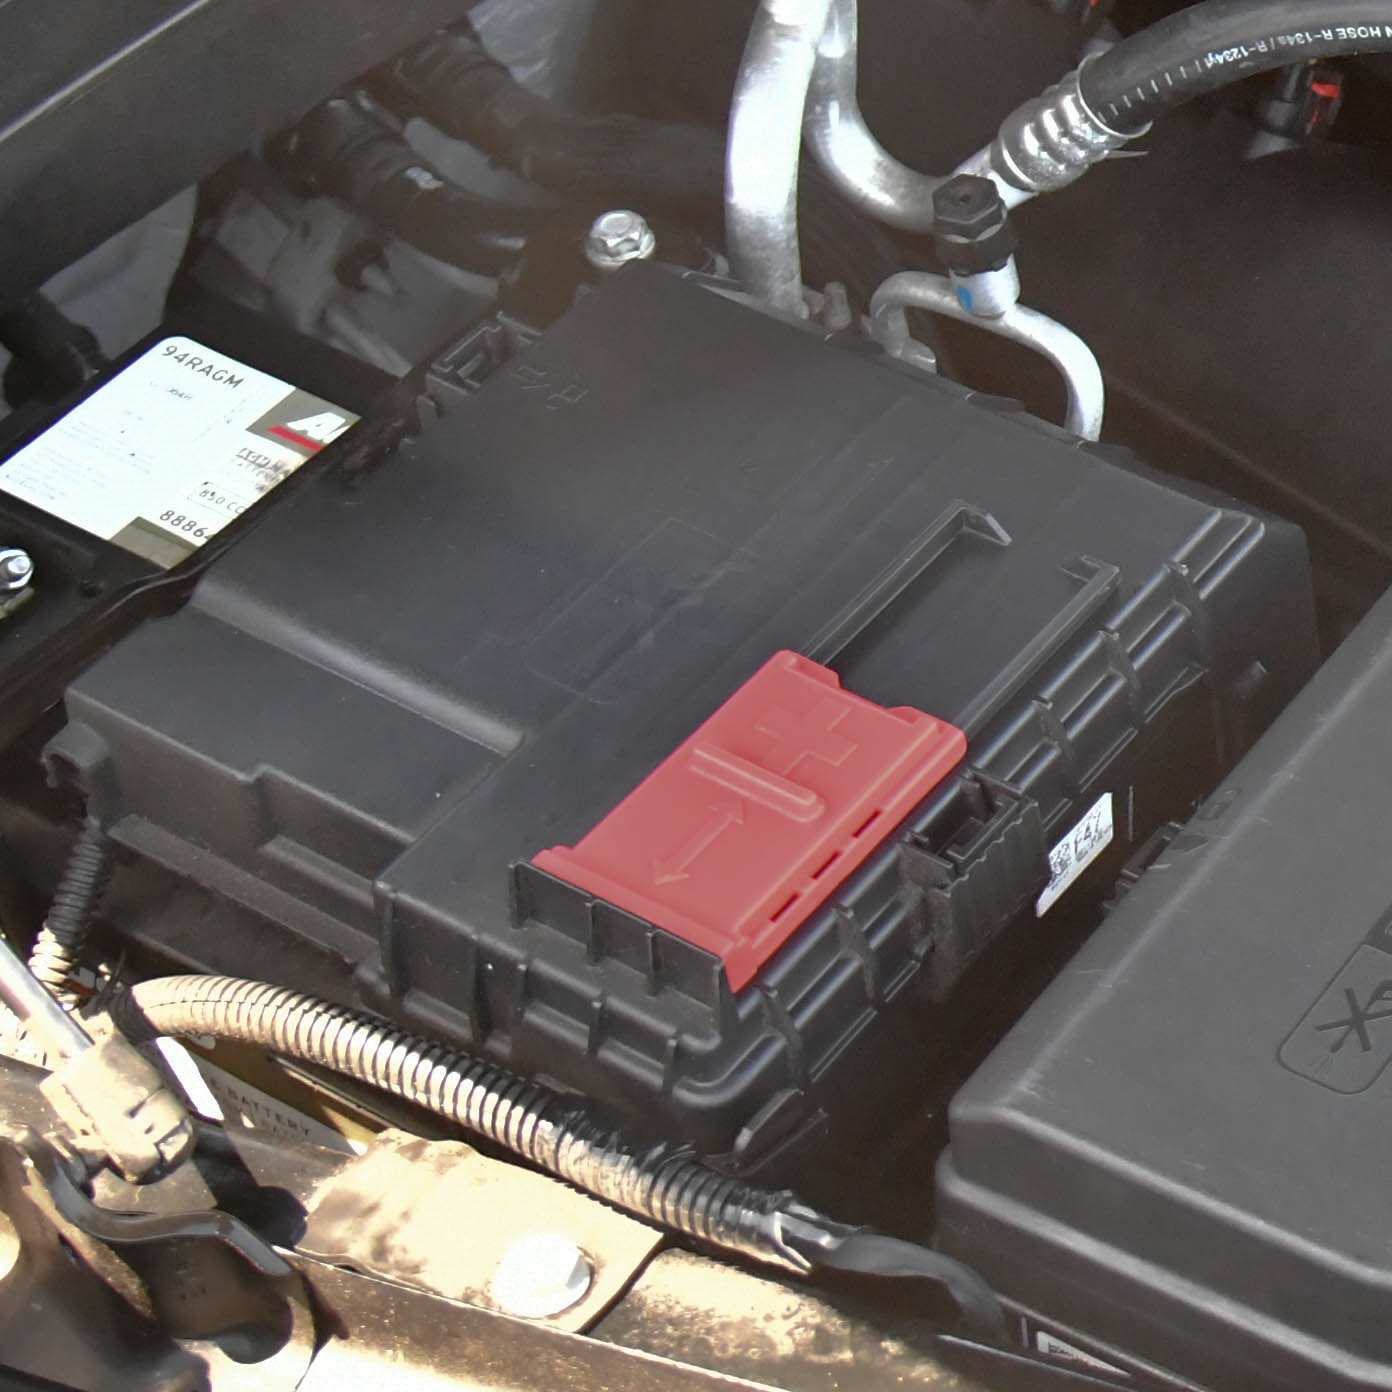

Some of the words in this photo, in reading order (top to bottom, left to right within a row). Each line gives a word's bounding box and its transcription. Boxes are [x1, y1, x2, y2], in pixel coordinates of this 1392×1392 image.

[1336, 25, 1382, 40] HOSE
[161, 344, 245, 391] 94RAGM
[159, 510, 214, 540] 8886
